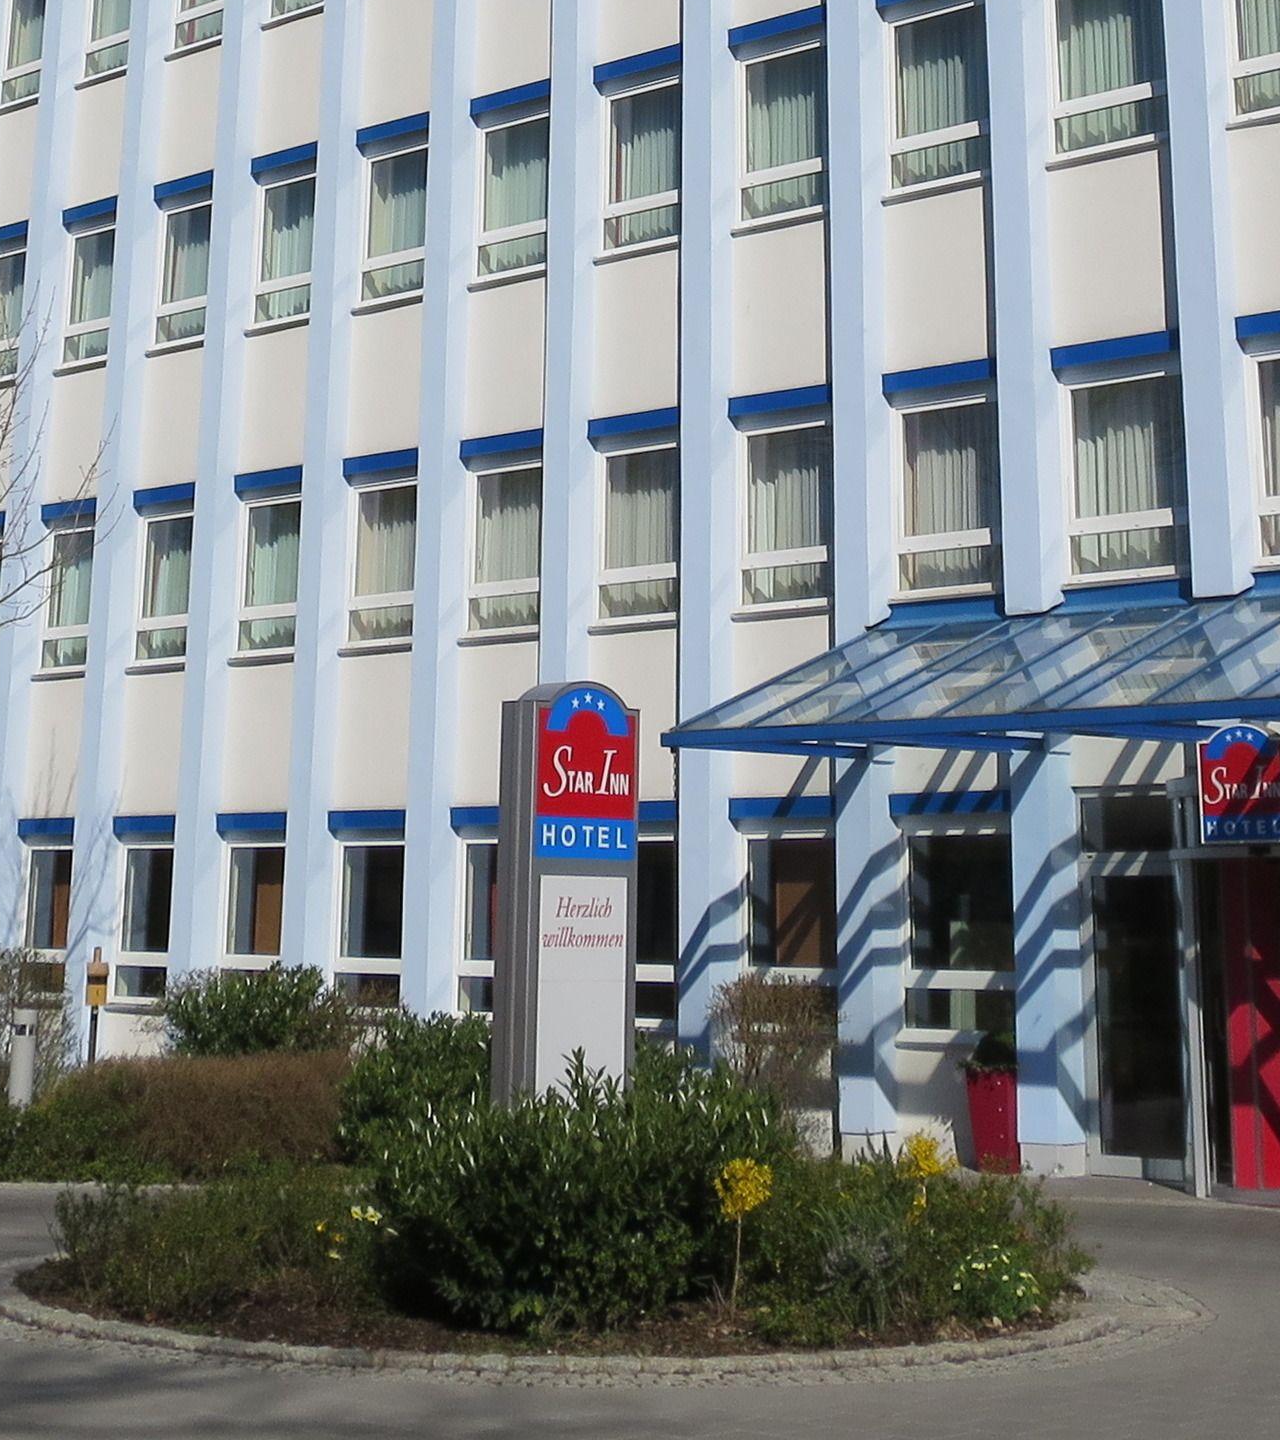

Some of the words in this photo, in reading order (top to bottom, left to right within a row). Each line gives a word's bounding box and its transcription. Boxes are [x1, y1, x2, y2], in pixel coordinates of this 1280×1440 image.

[543, 745, 594, 797] STAR
[595, 749, 629, 795] INN
[1204, 766, 1247, 804] STAR
[542, 823, 628, 849] HOTEL
[556, 895, 612, 918] Herzlich
[542, 926, 624, 948] willkommen
